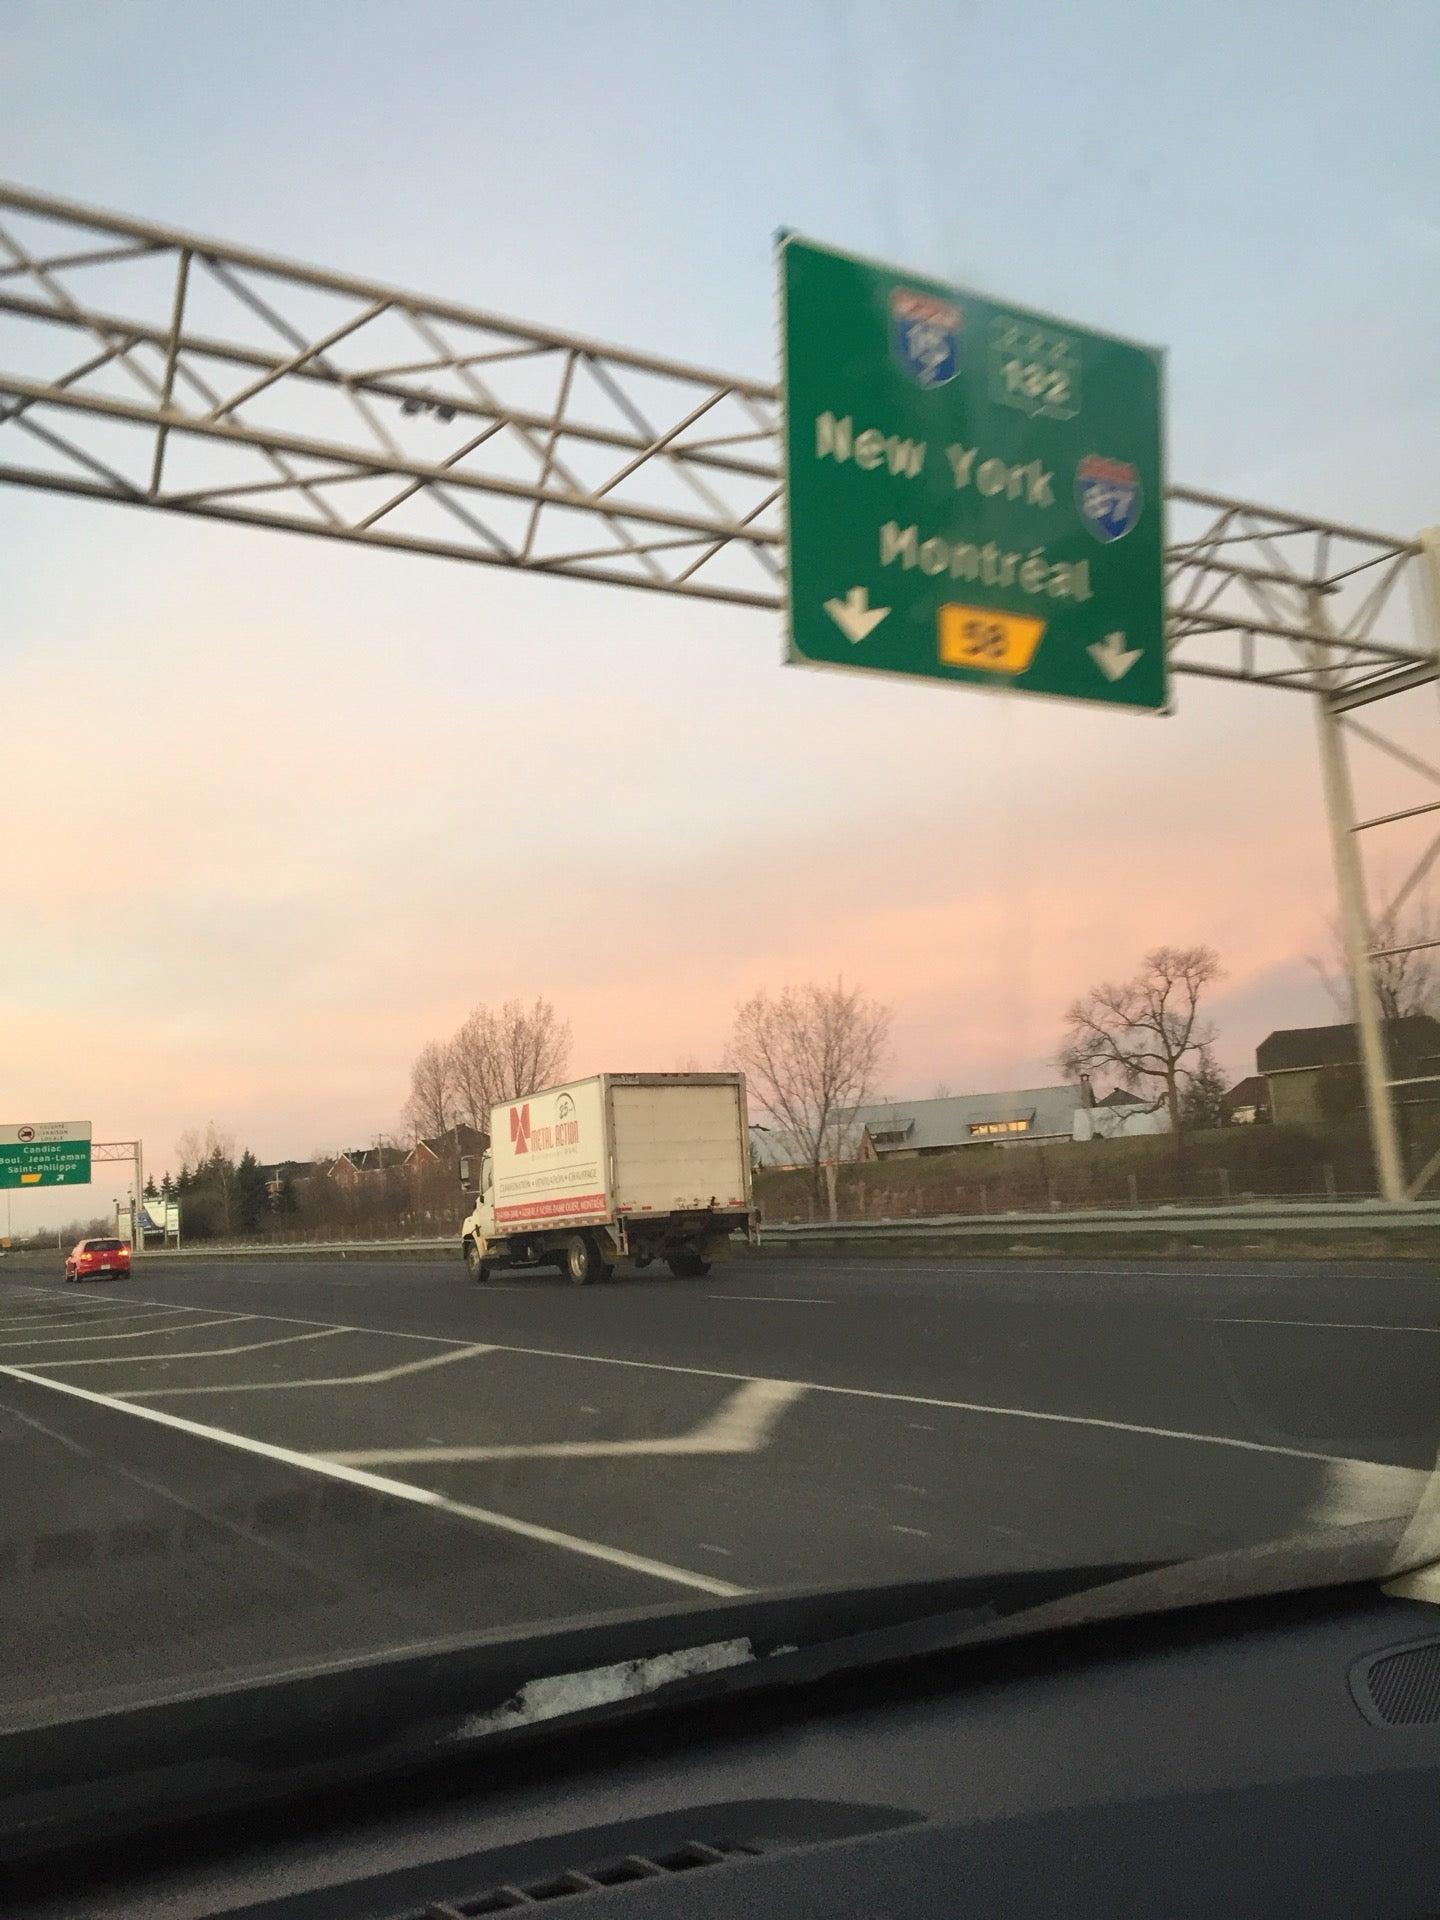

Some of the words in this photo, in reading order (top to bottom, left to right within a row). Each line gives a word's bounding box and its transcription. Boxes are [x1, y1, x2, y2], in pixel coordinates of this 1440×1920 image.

[816, 410, 927, 480] New
[944, 442, 1056, 508] York
[879, 520, 1094, 602] Montréal
[555, 1120, 579, 1147] ACTION
[23, 1145, 62, 1154] Candiac
[28, 1153, 86, 1163] Jean-Leman
[7, 1163, 77, 1174] Saint-Philippe
